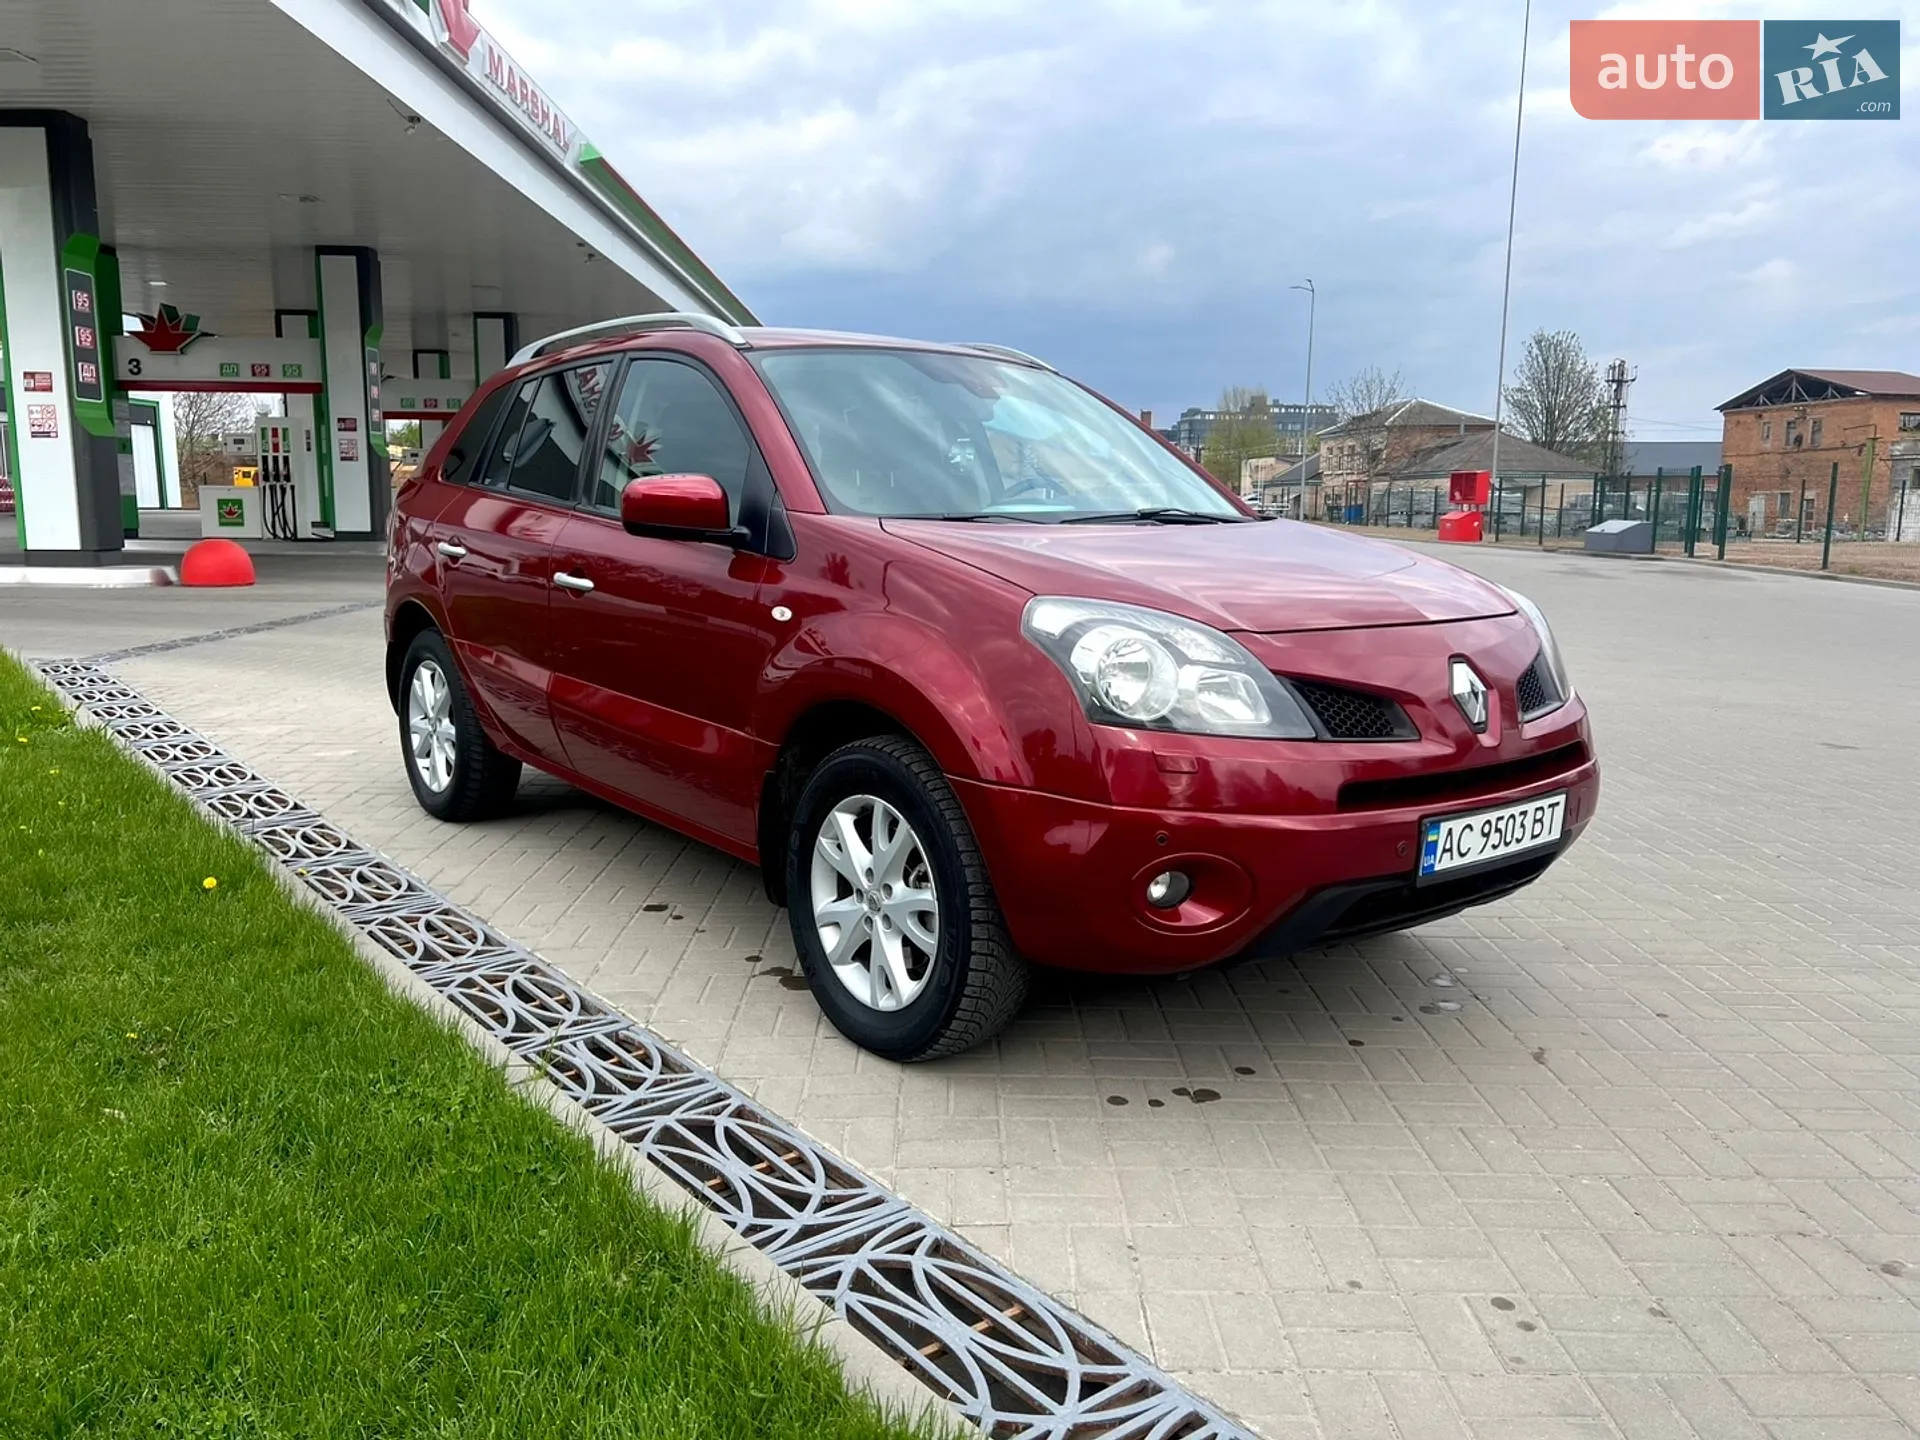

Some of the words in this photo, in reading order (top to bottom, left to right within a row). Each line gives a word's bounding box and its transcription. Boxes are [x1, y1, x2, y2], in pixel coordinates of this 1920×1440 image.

[128, 358, 142, 375] 3
[1438, 823, 1473, 863] AC
[1478, 810, 1527, 854] 9503
[1530, 802, 1560, 840] BT
